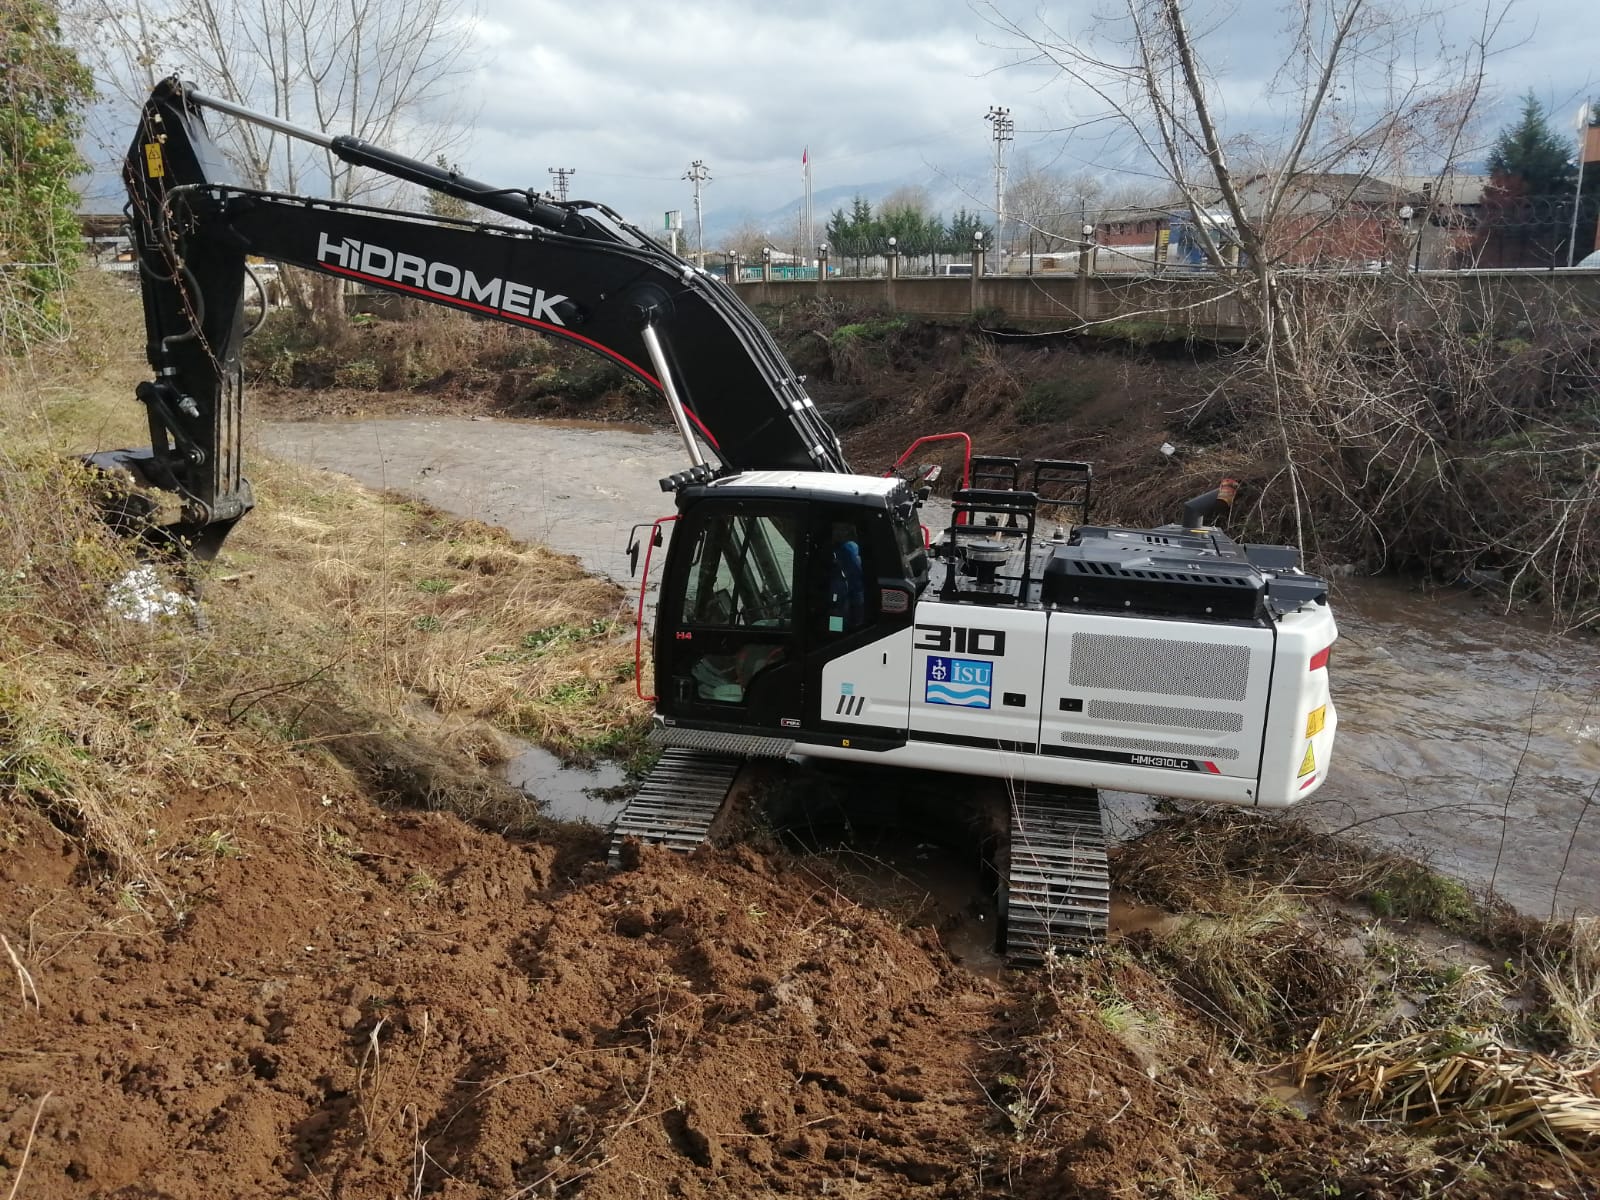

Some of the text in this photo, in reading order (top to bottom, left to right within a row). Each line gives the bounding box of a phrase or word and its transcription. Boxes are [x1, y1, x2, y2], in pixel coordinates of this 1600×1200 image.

[676, 631, 692, 640] H4
[914, 623, 1006, 656] 310
[1131, 754, 1189, 769] HMK310LC
